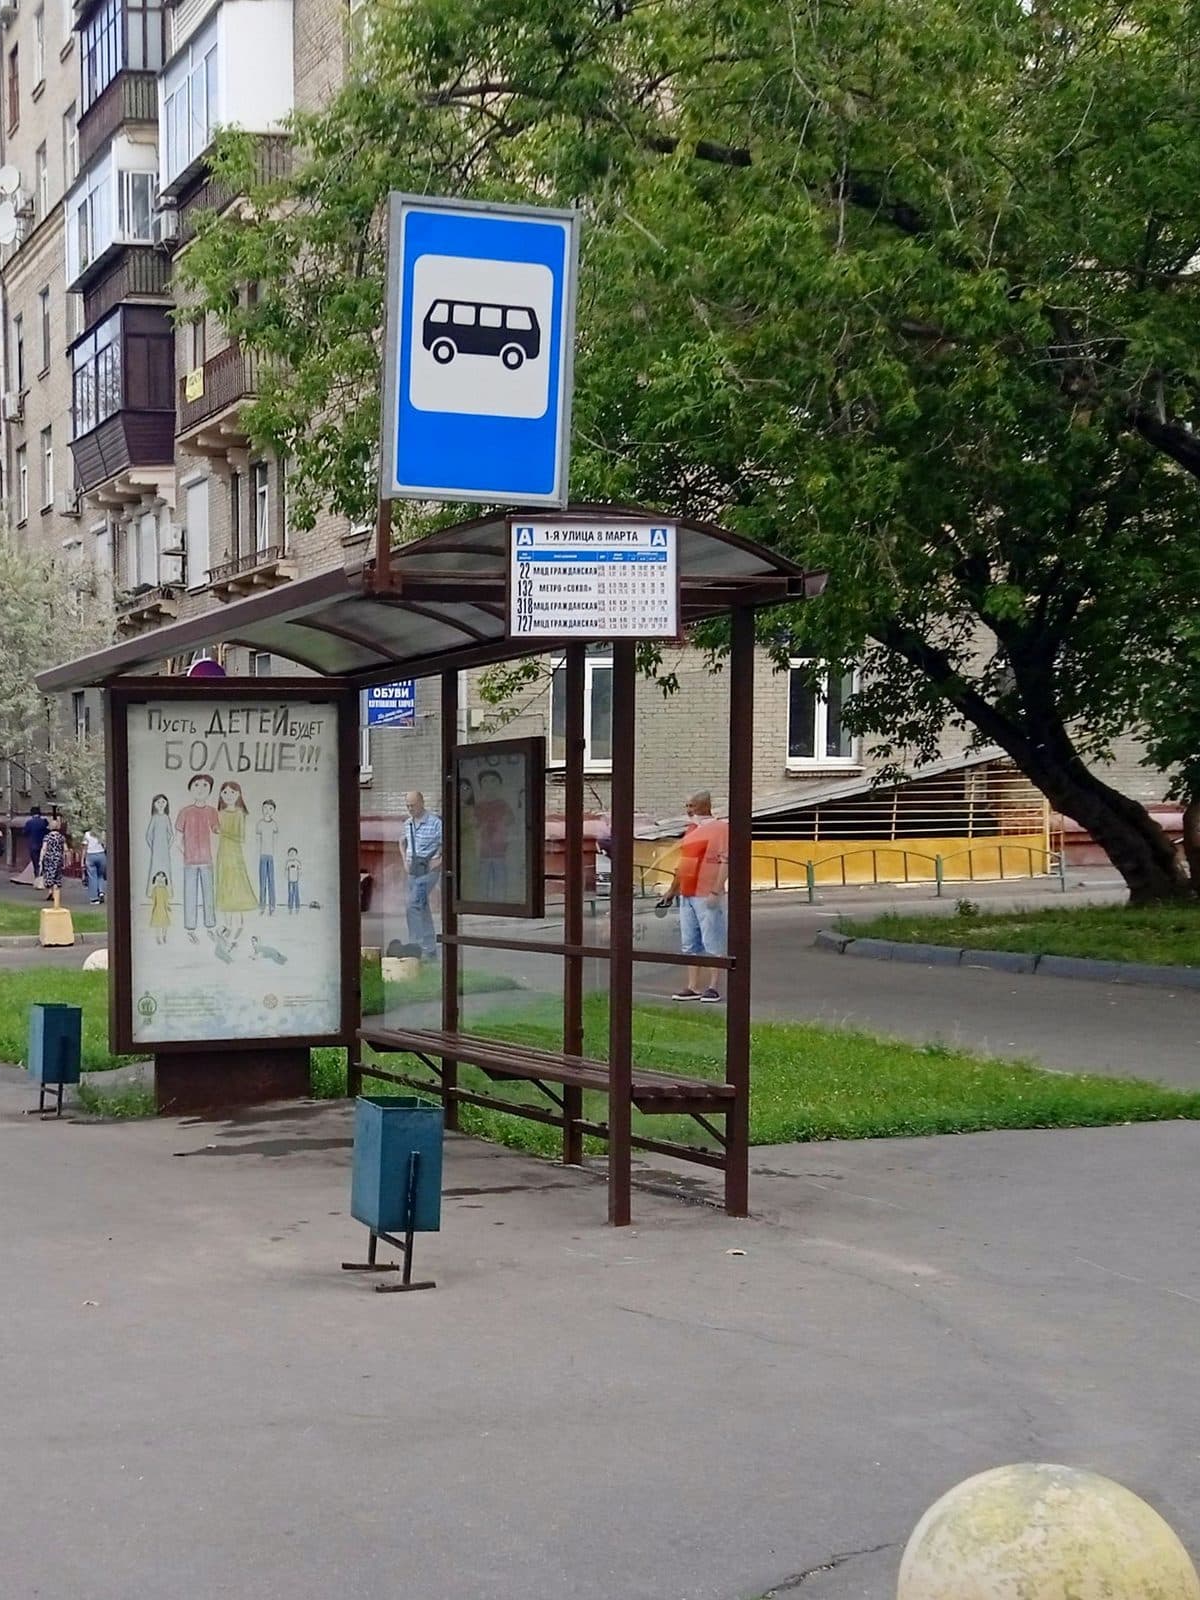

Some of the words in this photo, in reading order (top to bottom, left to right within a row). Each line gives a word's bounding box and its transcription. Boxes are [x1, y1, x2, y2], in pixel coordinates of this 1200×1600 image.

[545, 531, 559, 541] 1-Я
[563, 531, 594, 542] УЛИЦА
[597, 532, 603, 541] 8
[605, 531, 638, 541] МАРТА
[519, 563, 530, 579] 22
[518, 580, 533, 597] 132
[539, 584, 561, 592] МЕТРО
[517, 598, 533, 614] 318
[517, 615, 533, 632] 727
[373, 688, 409, 698] ОБУВИ
[204, 704, 289, 738] ДЕТЕЙ
[165, 740, 321, 773] БОЛЬШЕ!!!
